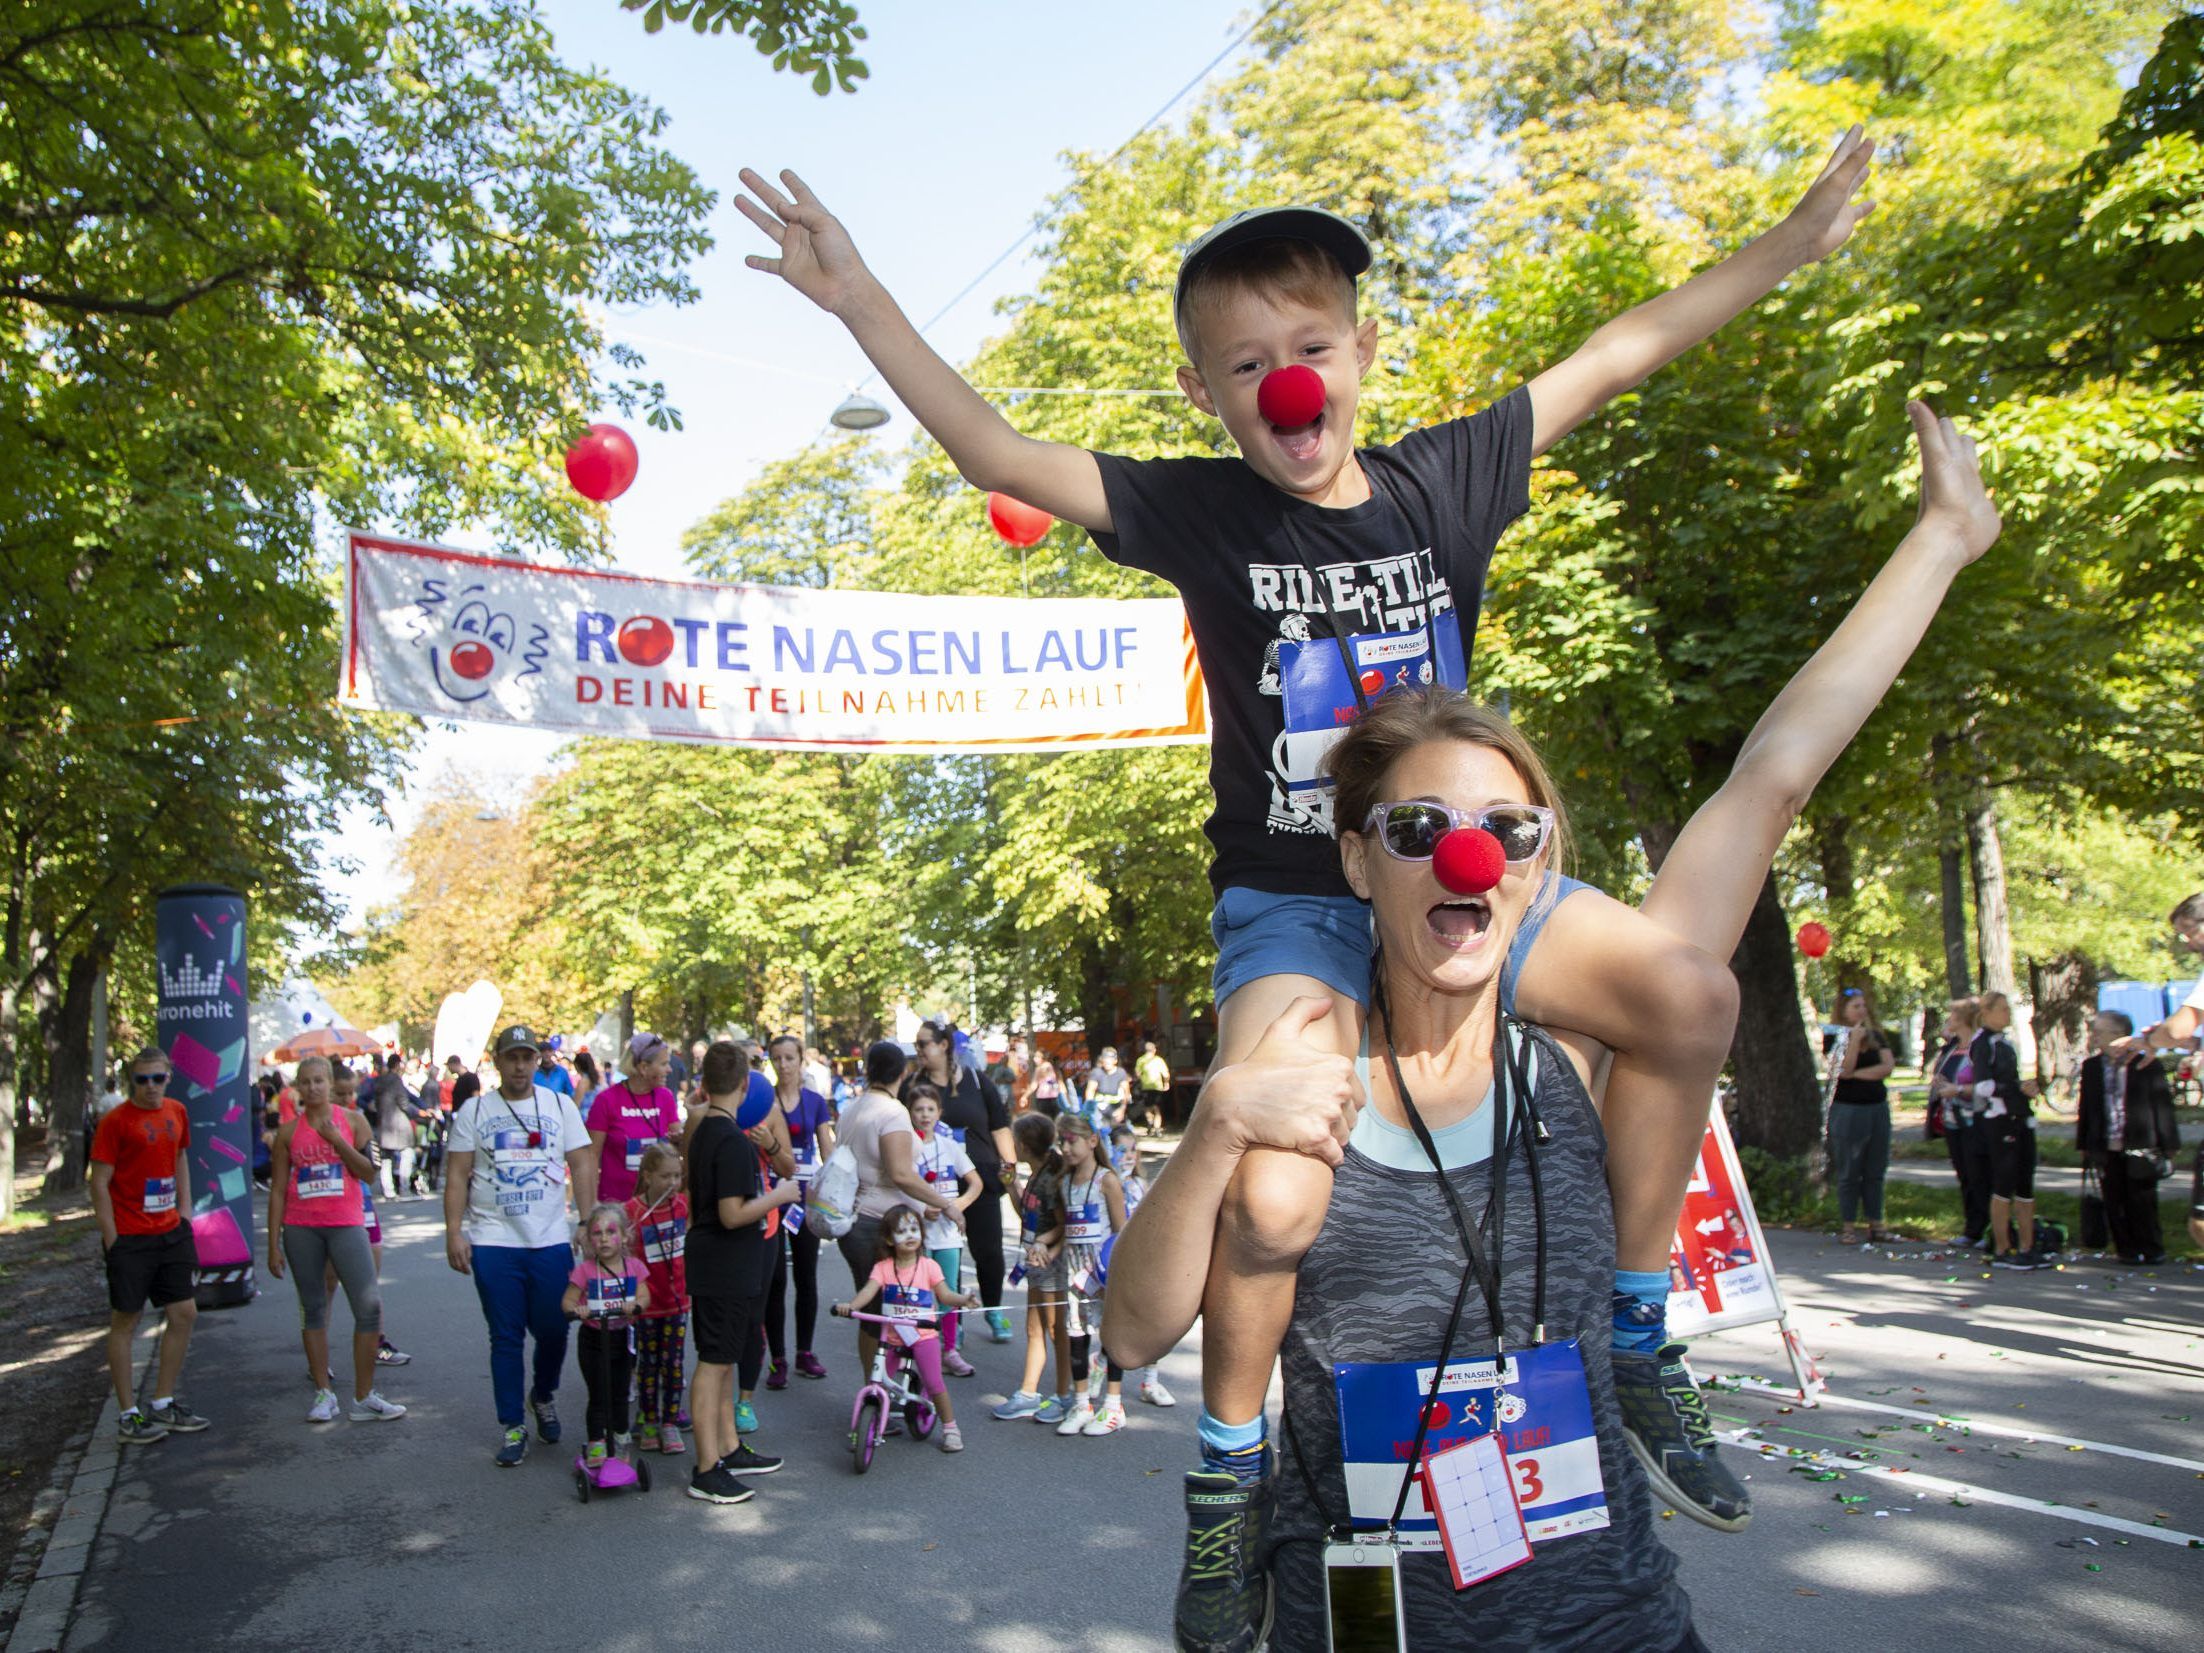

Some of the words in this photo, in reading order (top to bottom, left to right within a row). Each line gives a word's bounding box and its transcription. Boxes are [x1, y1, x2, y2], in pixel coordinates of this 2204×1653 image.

[576, 611, 750, 672] ROTE
[773, 625, 982, 676] NASEN
[1001, 627, 1138, 675] LAUF
[576, 675, 717, 710] DEINE
[744, 686, 990, 715] TEILNAHME
[158, 1000, 234, 1020] ronehit
[1442, 1372, 1463, 1381] ROTE
[1464, 1369, 1492, 1379] NASEN
